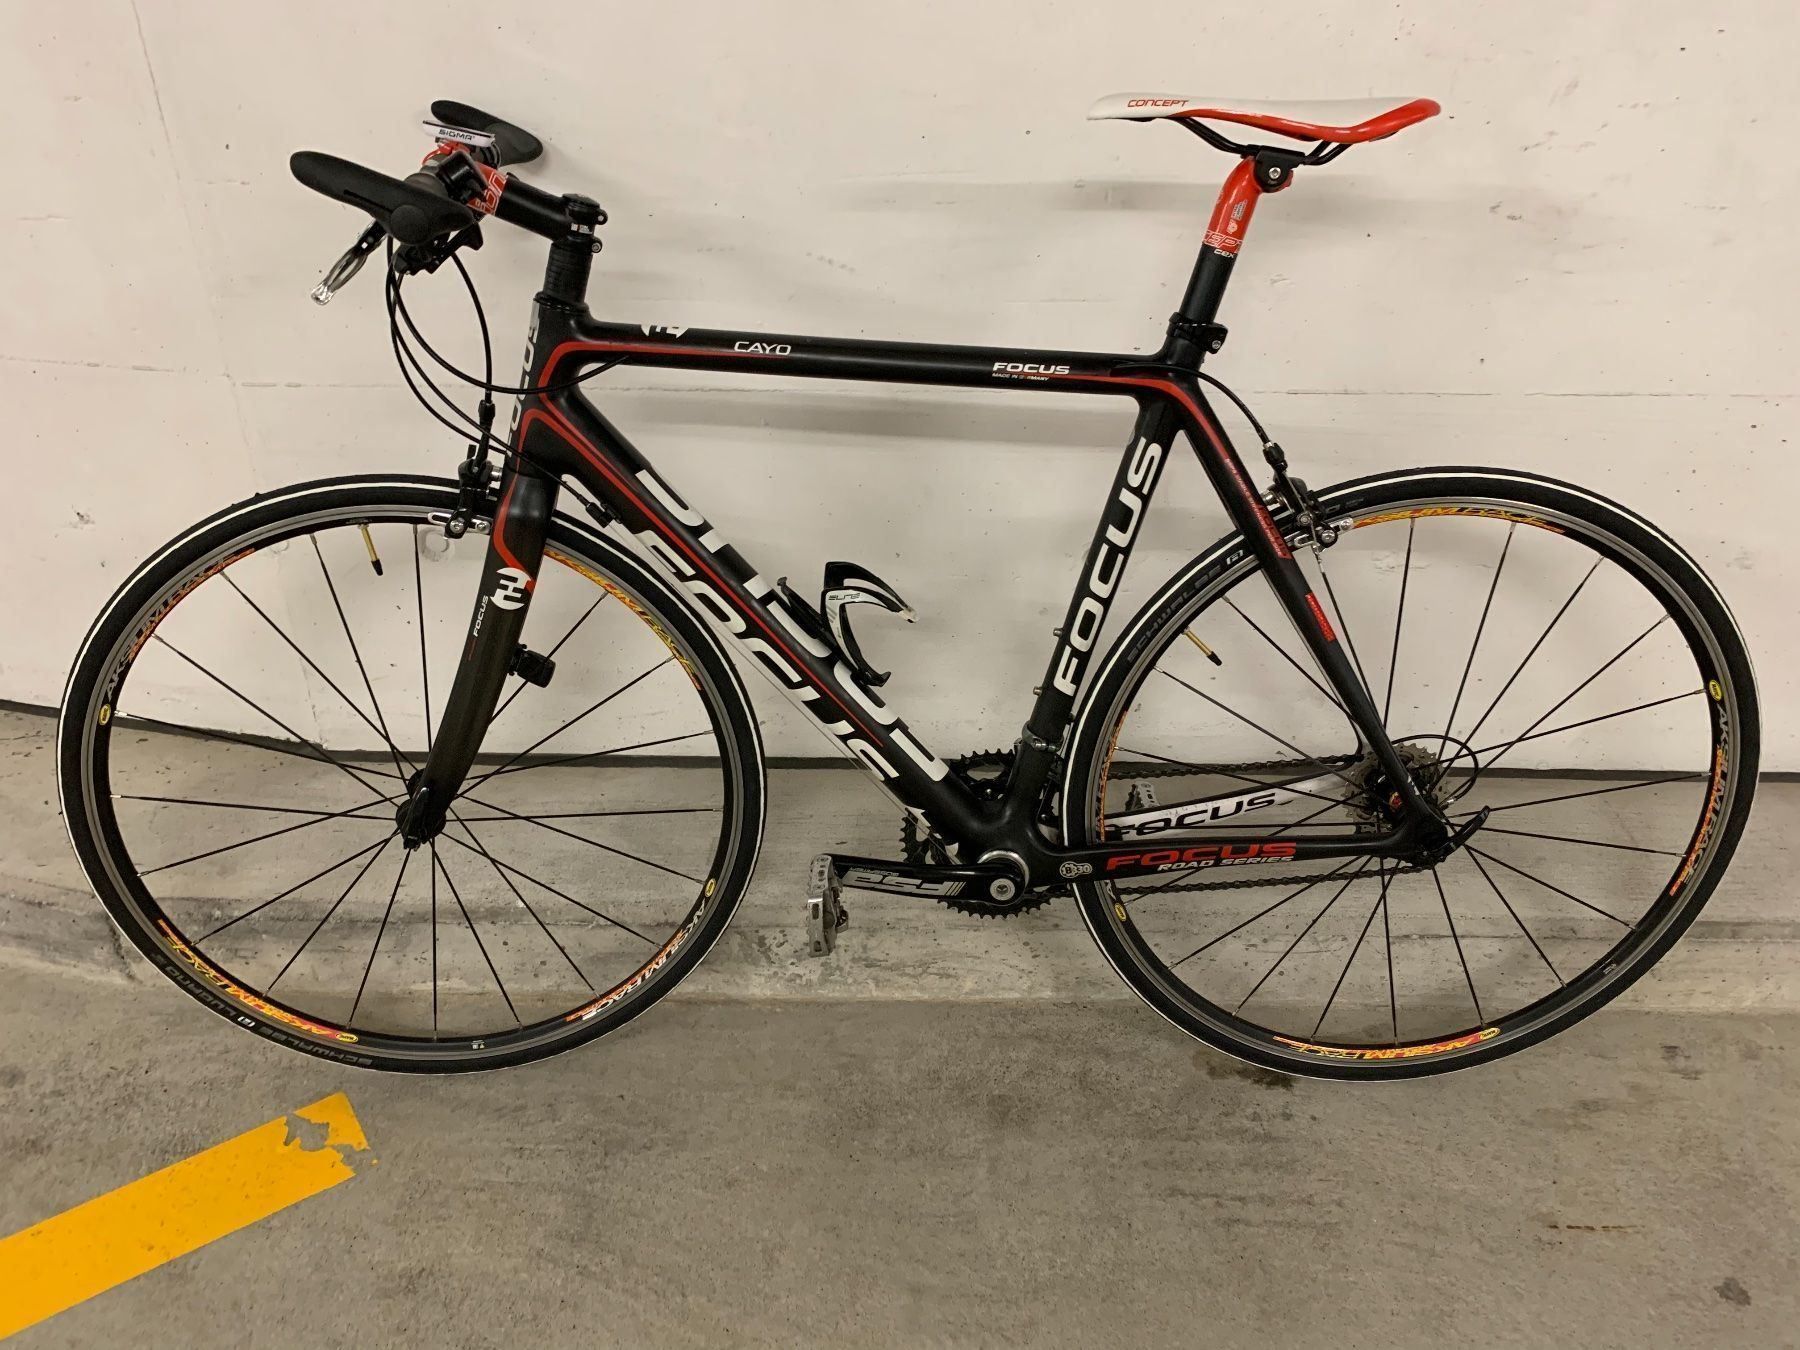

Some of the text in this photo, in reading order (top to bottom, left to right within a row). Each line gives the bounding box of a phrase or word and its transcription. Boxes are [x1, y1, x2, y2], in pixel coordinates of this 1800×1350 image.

[1127, 99, 1190, 108] CONCEPT
[438, 128, 473, 141] SIGMA
[733, 341, 792, 356] CAYO
[992, 362, 1070, 375] FOCUS
[1052, 436, 1163, 697] FOCUS
[473, 595, 489, 637] FOCUS
[1106, 843, 1297, 871] FOCUS
[1156, 856, 1295, 872] ROAD SERIES
[259, 1026, 373, 1066] SCHWALBE
